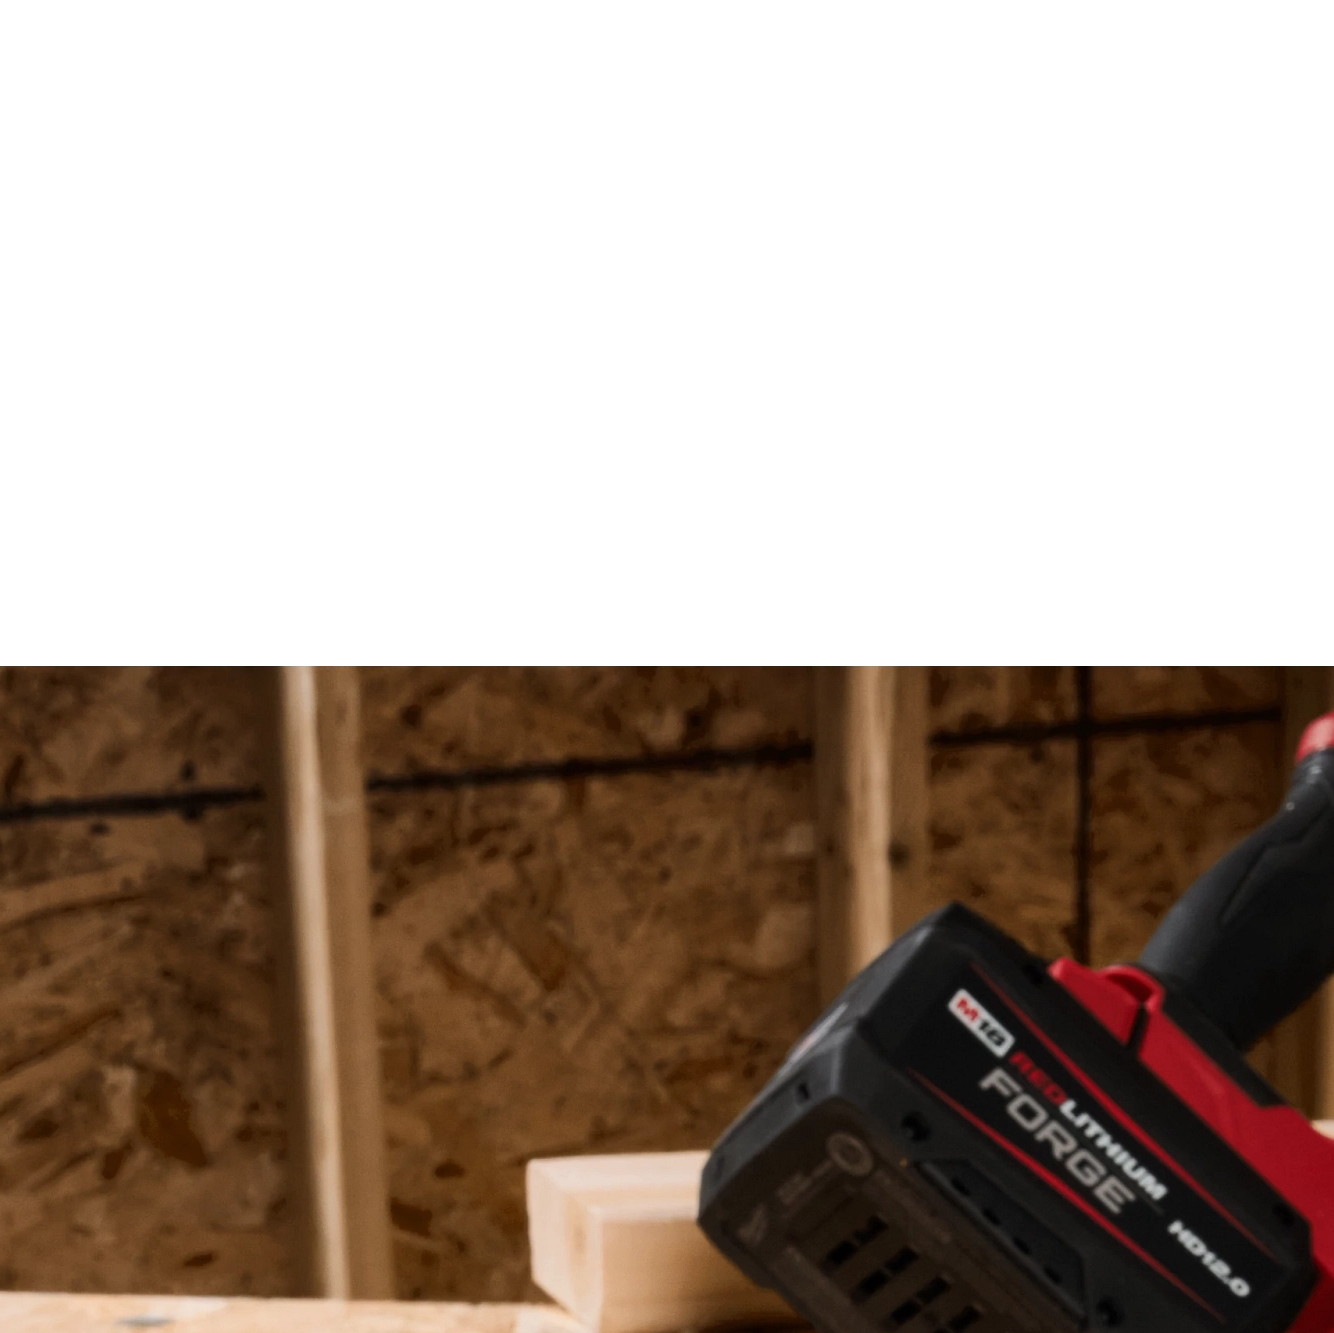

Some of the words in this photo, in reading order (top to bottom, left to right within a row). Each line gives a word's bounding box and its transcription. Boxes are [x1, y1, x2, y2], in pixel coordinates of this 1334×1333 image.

[956, 997, 1007, 1050] M18
[1009, 1050, 1169, 1201] REDLITHIUM
[979, 1066, 1137, 1214] FORGE
[1168, 1219, 1251, 1297] HD12.0
